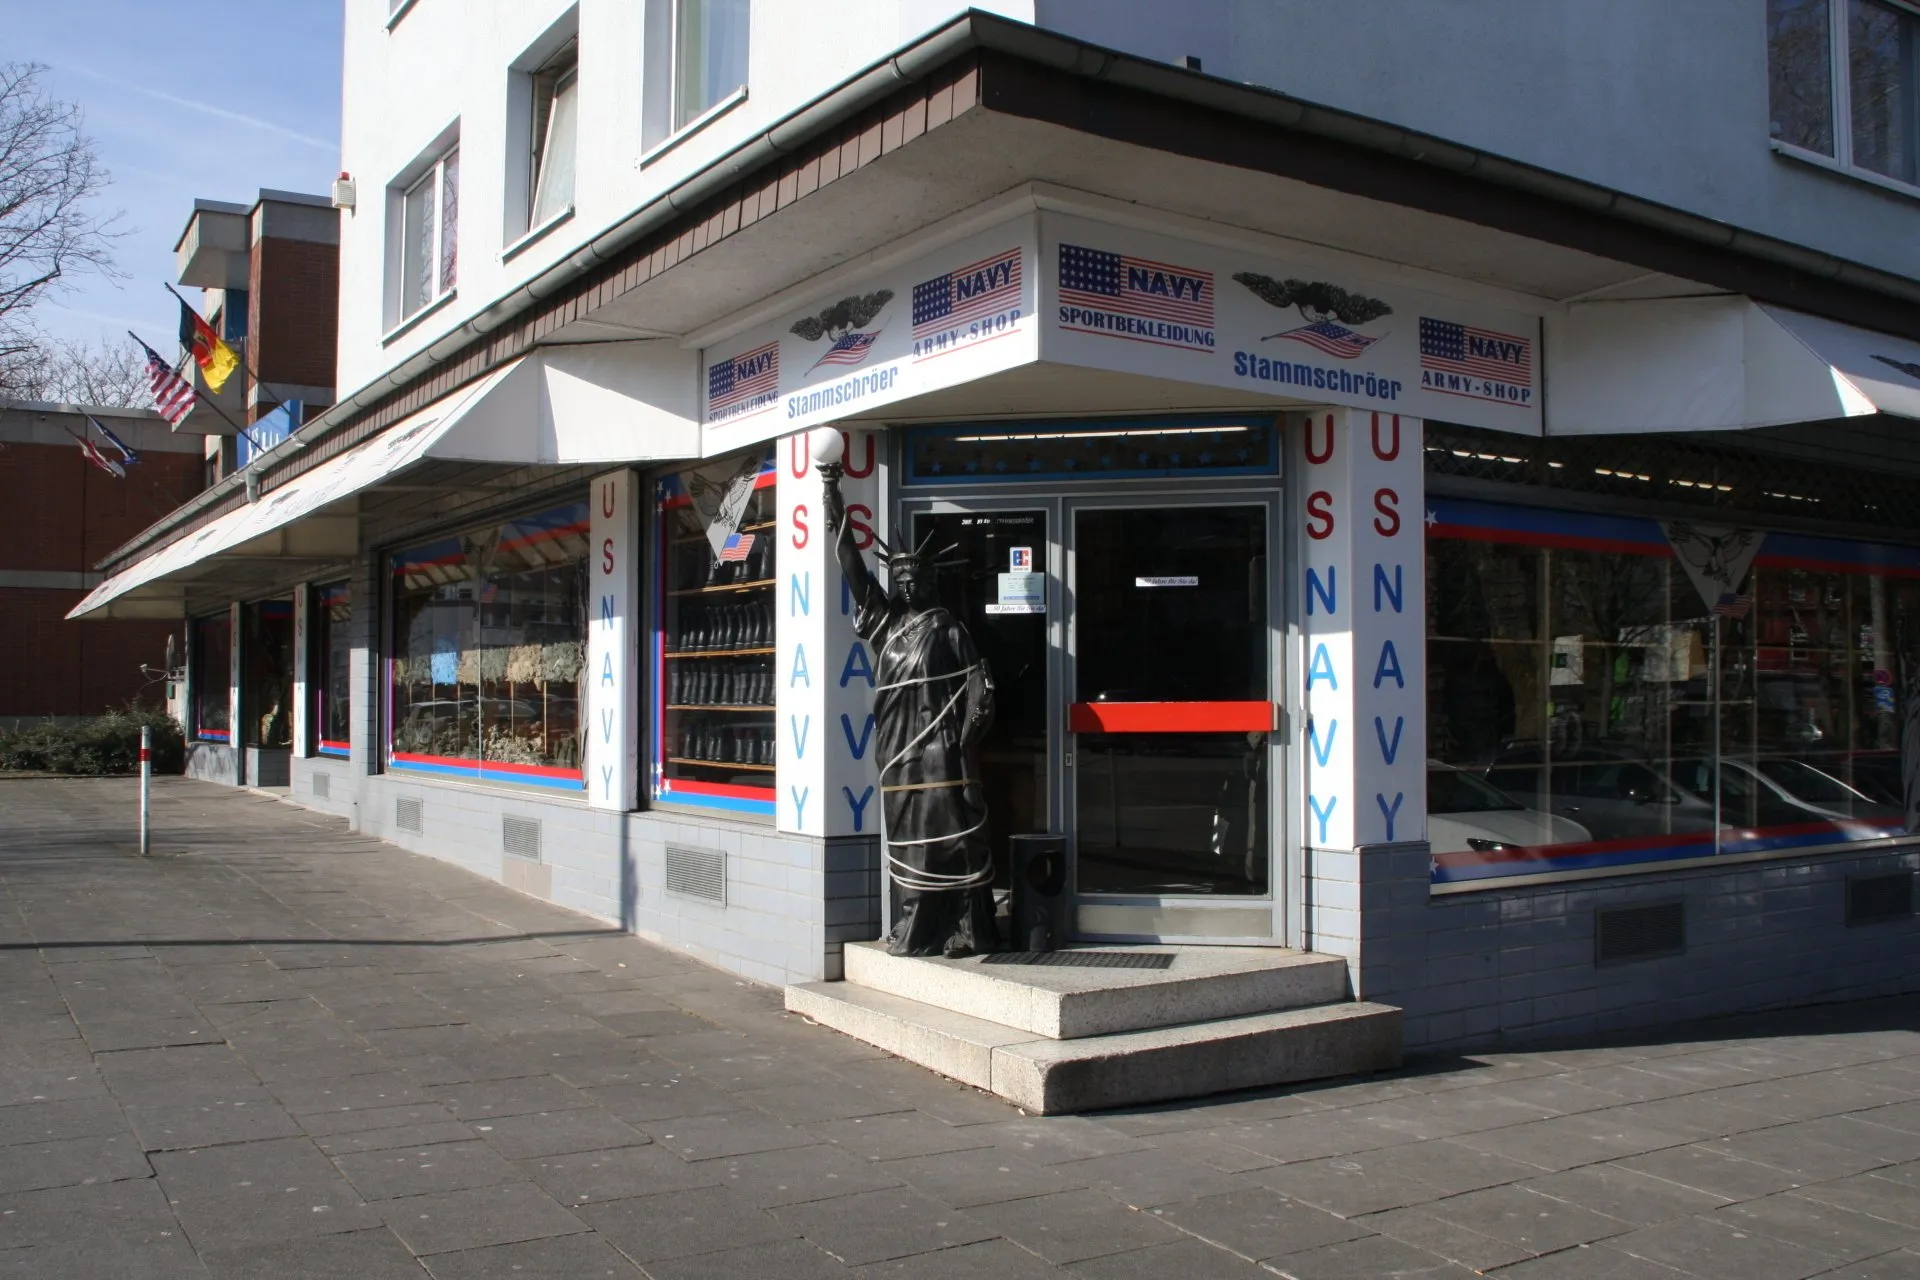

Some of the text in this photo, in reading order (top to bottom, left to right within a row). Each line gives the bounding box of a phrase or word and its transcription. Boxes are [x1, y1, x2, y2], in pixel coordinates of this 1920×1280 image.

[955, 258, 1014, 302] NAVY
[1128, 267, 1204, 302] NAVY
[1058, 306, 1216, 347] SPORTBEKLEIDUNG
[737, 350, 774, 381] NAVY
[1468, 335, 1524, 364] NAVY
[787, 366, 899, 419] Stammschröer
[1234, 351, 1402, 400] Stammschröer
[708, 390, 779, 423] SPORTBEKLEIDUNG
